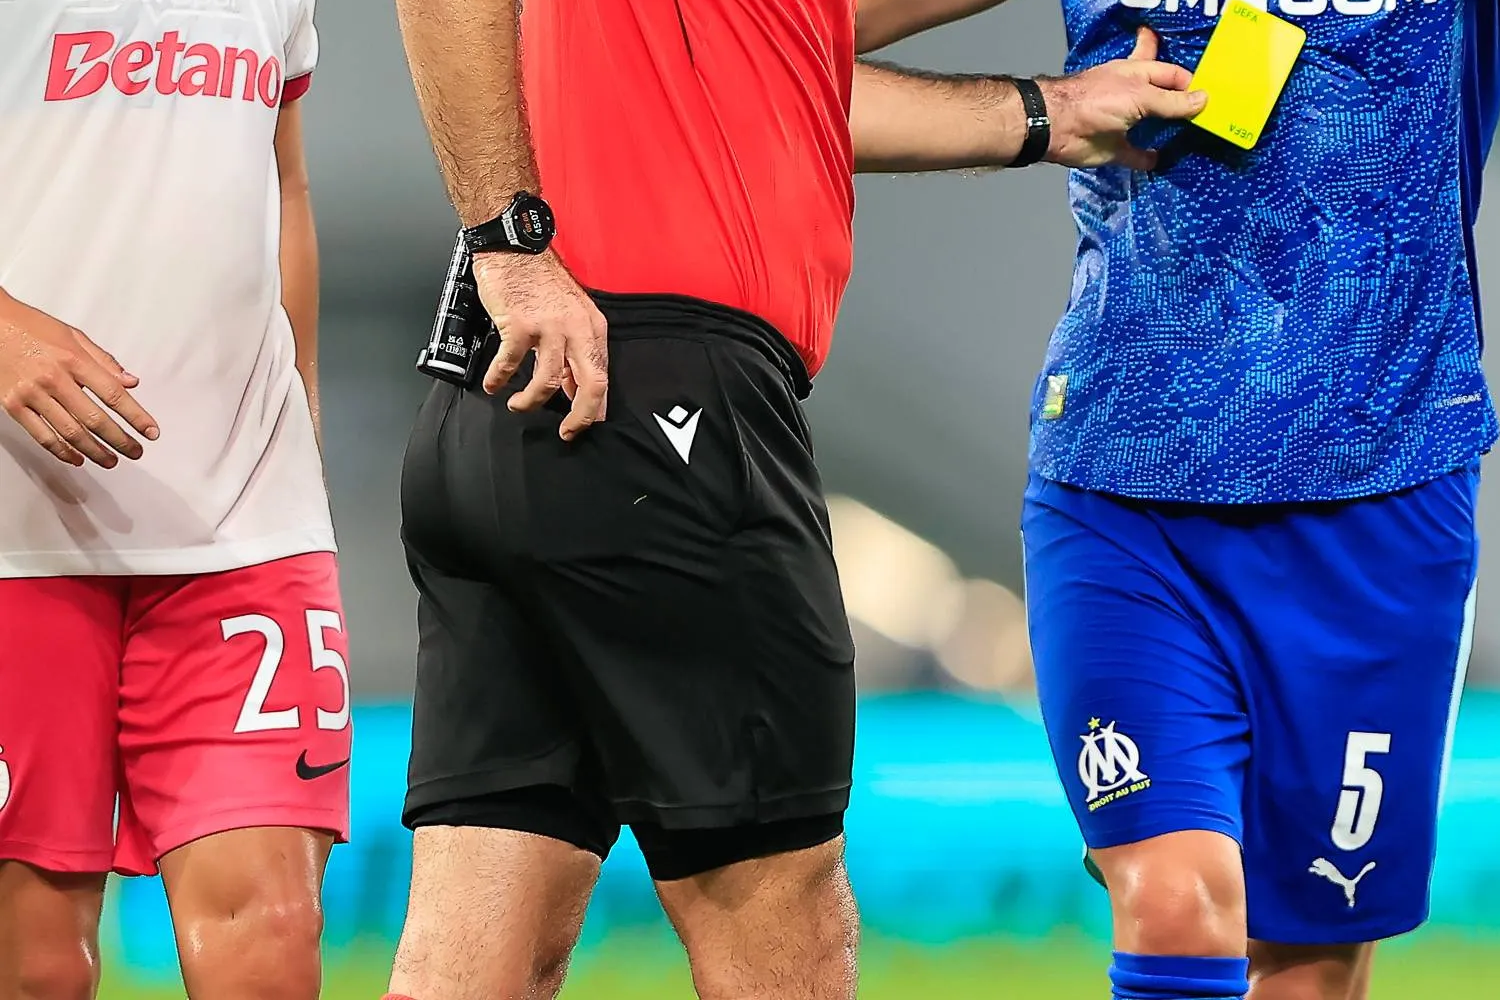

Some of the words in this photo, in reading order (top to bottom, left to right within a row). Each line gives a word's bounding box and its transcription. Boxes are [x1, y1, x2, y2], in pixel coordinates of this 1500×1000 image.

[1233, 4, 1258, 23] UEFA
[44, 30, 281, 109] Betano
[1229, 122, 1254, 142] UEFA
[528, 209, 543, 235] 45:07
[220, 608, 350, 735] 25
[1088, 792, 1115, 813] DROIT
[1115, 787, 1130, 799] AU
[1129, 778, 1151, 793] BUT
[1330, 730, 1391, 851] 5
